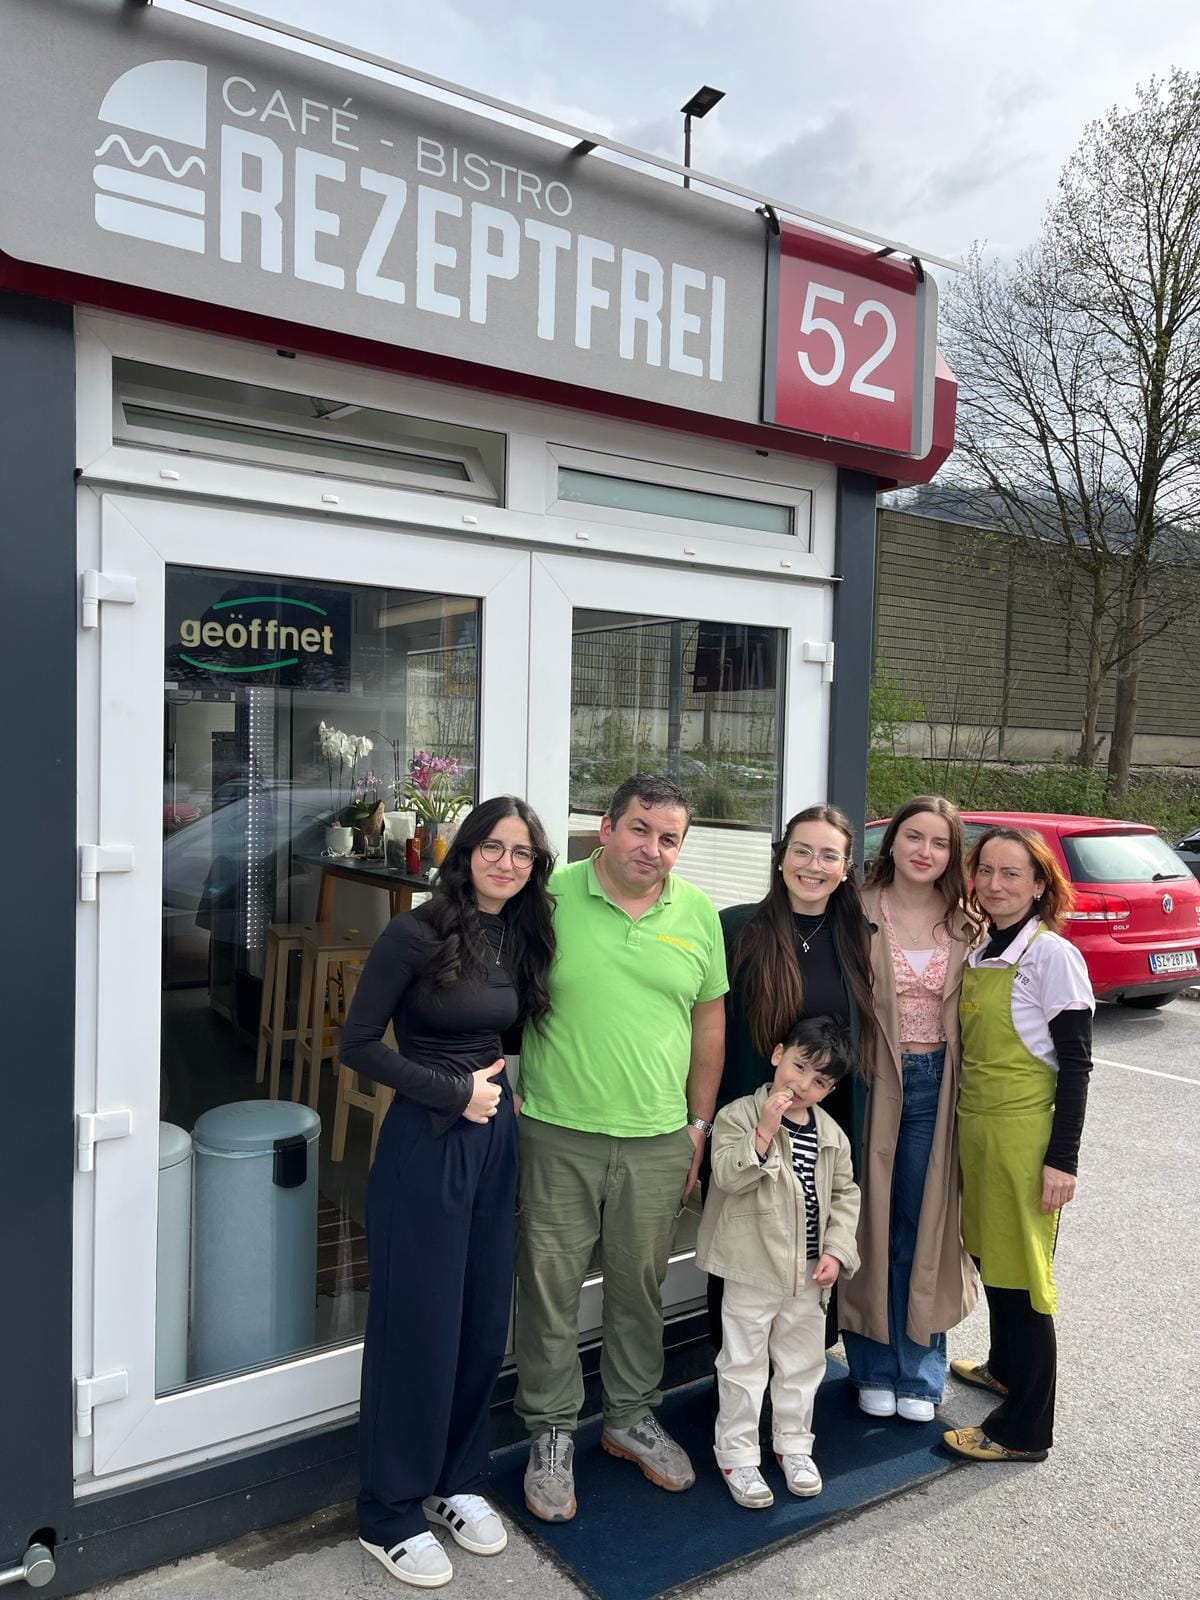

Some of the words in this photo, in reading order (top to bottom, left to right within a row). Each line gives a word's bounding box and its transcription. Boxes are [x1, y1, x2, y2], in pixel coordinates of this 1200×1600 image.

[222, 76, 359, 152] CAFÉ
[416, 136, 573, 217] BISTRO
[219, 123, 726, 382] REZEPTFREI
[797, 281, 898, 402] 52
[180, 613, 333, 655] geöffnet
